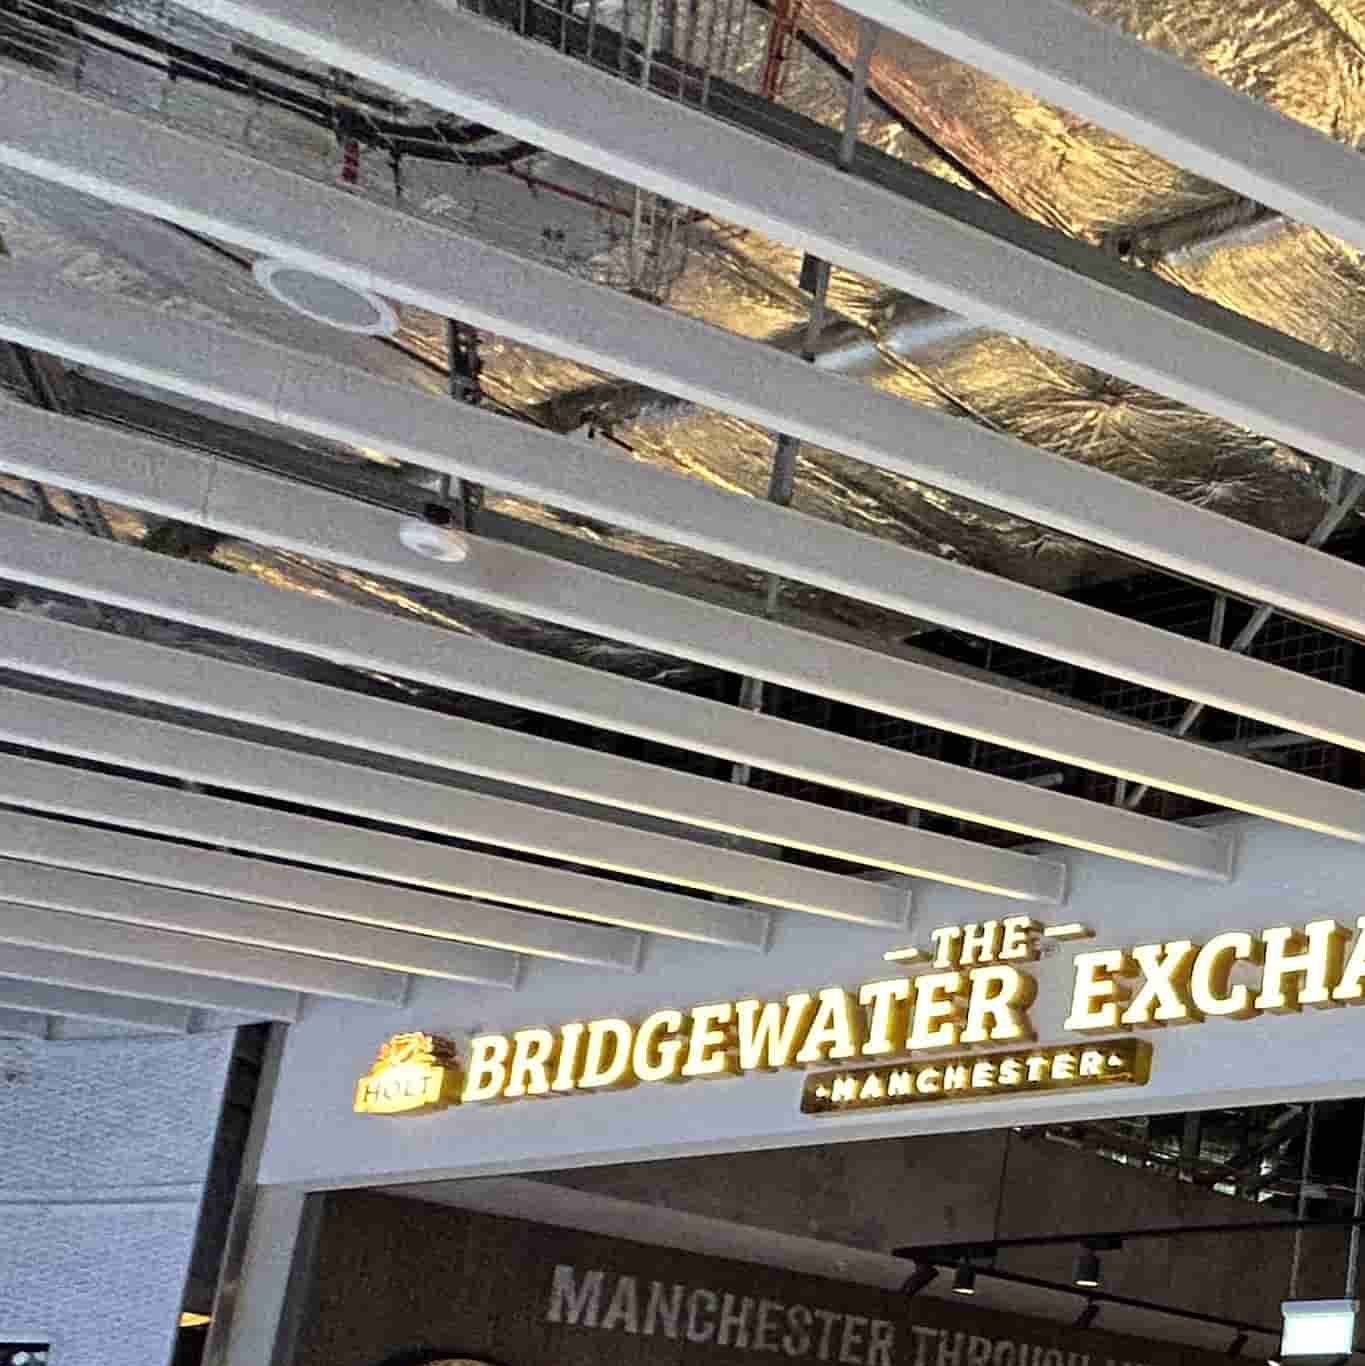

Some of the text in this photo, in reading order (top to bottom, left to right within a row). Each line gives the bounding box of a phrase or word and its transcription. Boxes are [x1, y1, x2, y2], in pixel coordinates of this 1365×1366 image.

[931, 915, 1034, 969] THE
[461, 964, 1030, 1103] BRIDGEWATER
[830, 1050, 1103, 1102] MANCHESTER
